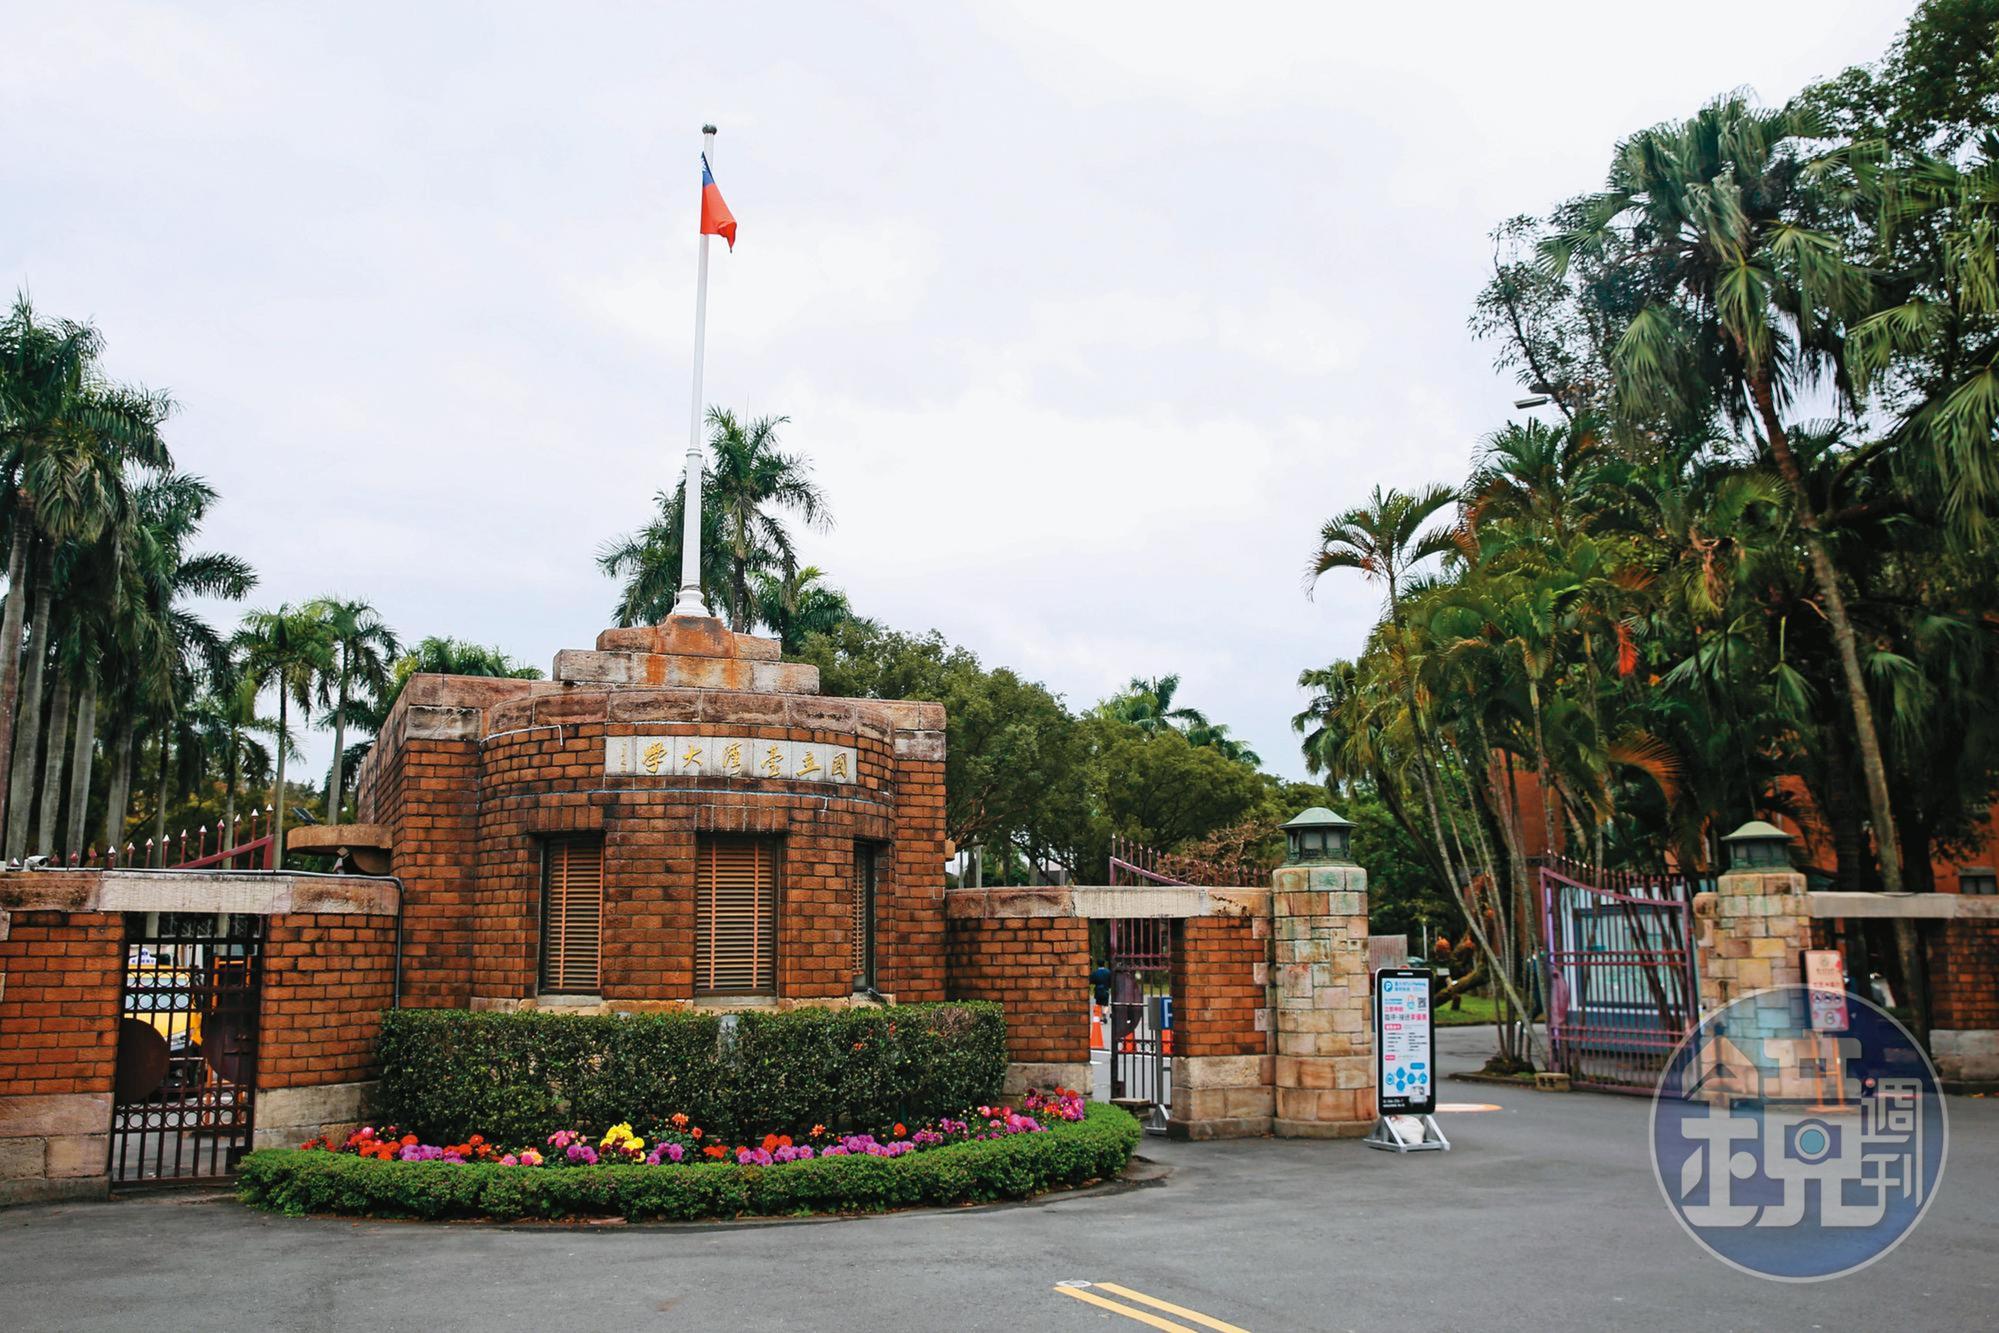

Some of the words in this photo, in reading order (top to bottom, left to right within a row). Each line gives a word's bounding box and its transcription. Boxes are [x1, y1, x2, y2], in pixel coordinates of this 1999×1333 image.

[641, 740, 848, 780] 國立臺灣大學
